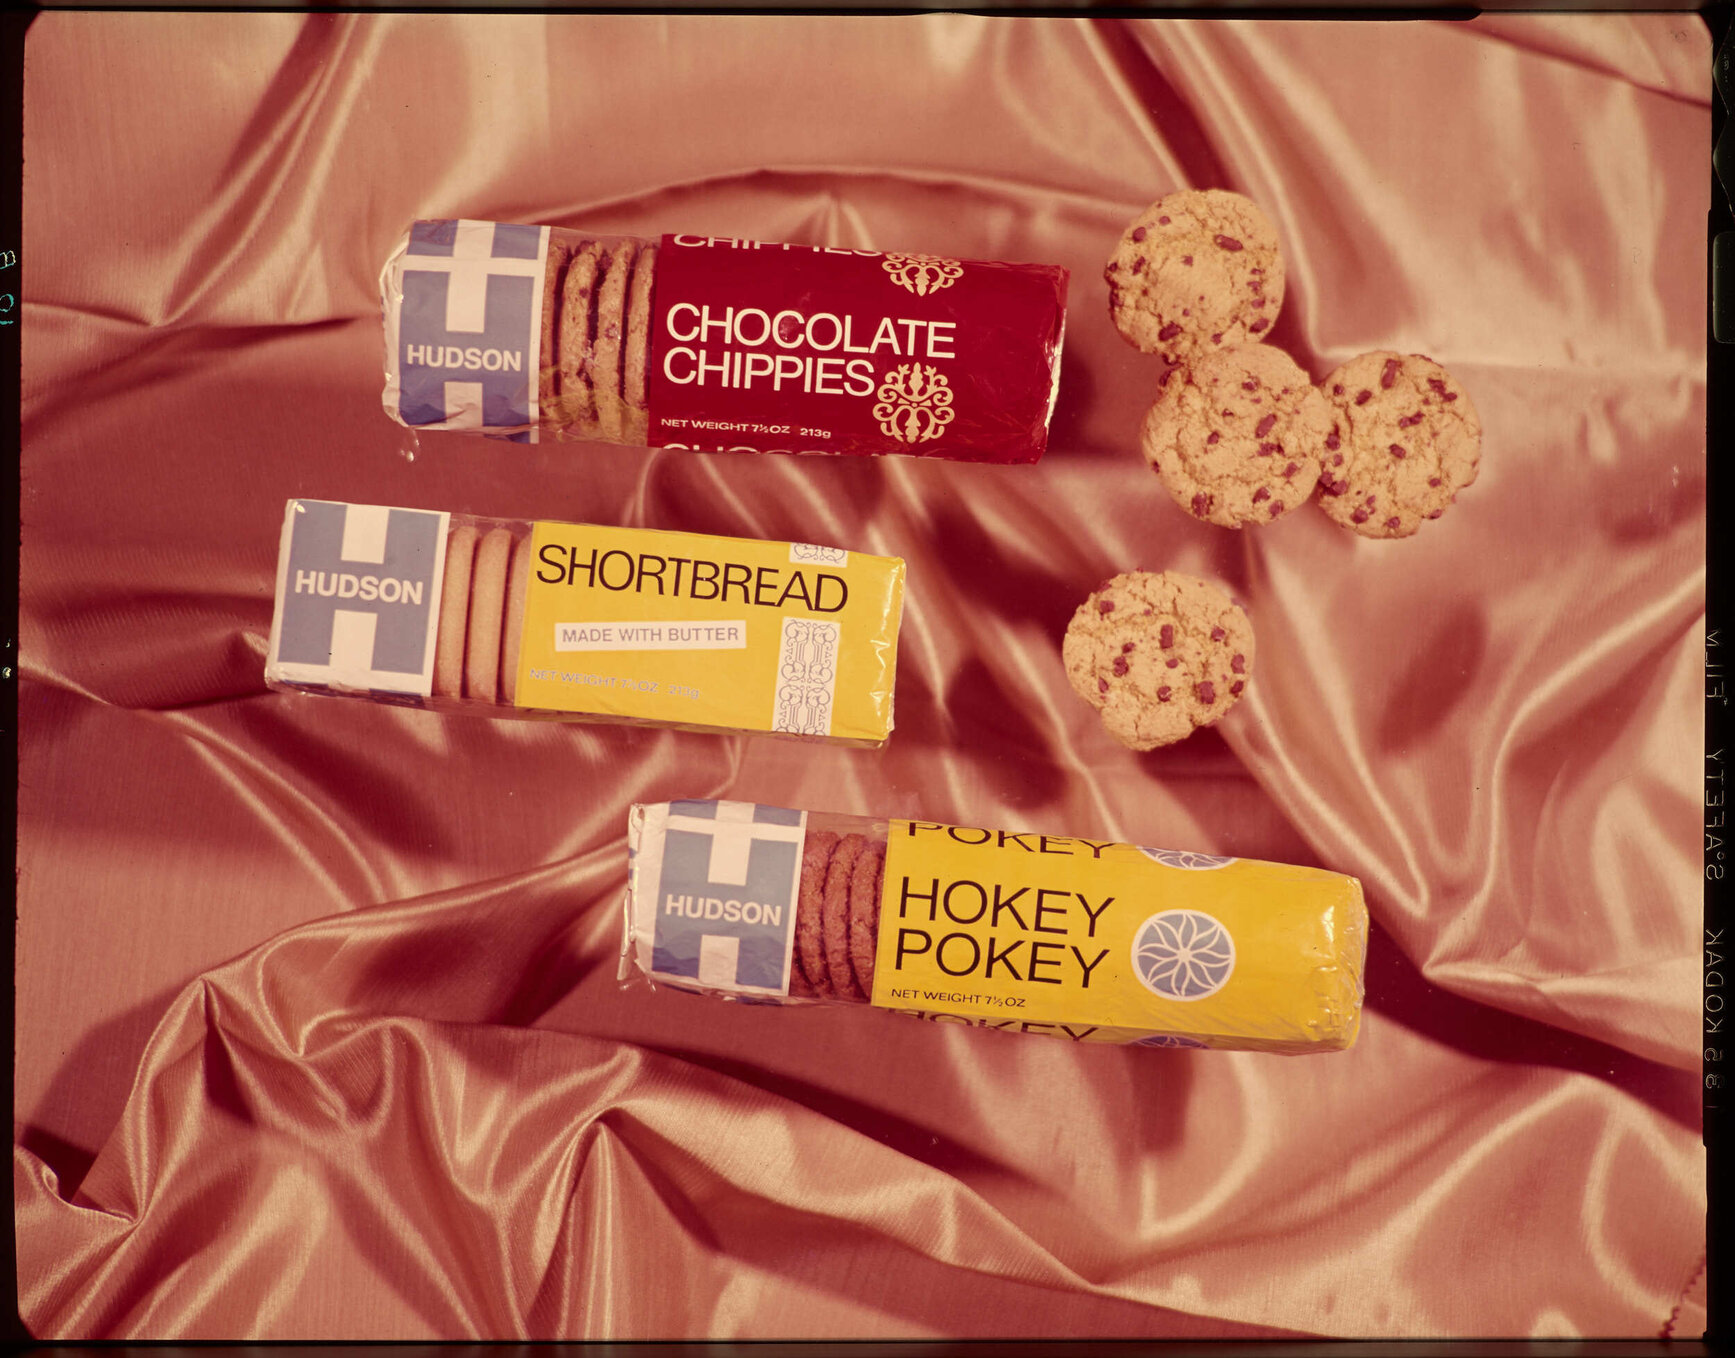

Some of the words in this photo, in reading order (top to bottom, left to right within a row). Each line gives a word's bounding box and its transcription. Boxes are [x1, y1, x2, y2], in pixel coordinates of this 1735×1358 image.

[666, 302, 957, 360] CHOCOLATE
[406, 343, 522, 373] HUDSON
[662, 346, 876, 398] CHIPPIES
[660, 418, 689, 430] NET
[690, 420, 749, 433] WEIGHT
[799, 427, 832, 439] 213g
[295, 569, 424, 606] HUDSON
[536, 544, 849, 614] SHORTBREAD
[562, 628, 613, 643] MADE
[618, 628, 663, 642] WITH
[668, 626, 739, 642] BUTTER
[529, 668, 558, 682] NET
[560, 671, 617, 689] WEIGHT
[908, 822, 1117, 860] POKEY
[665, 893, 783, 927] HUDSON
[898, 876, 1116, 938] HOKEY
[895, 928, 1111, 989] POKEY
[890, 988, 920, 1000] NET
[922, 991, 983, 1005] WEIGHT
